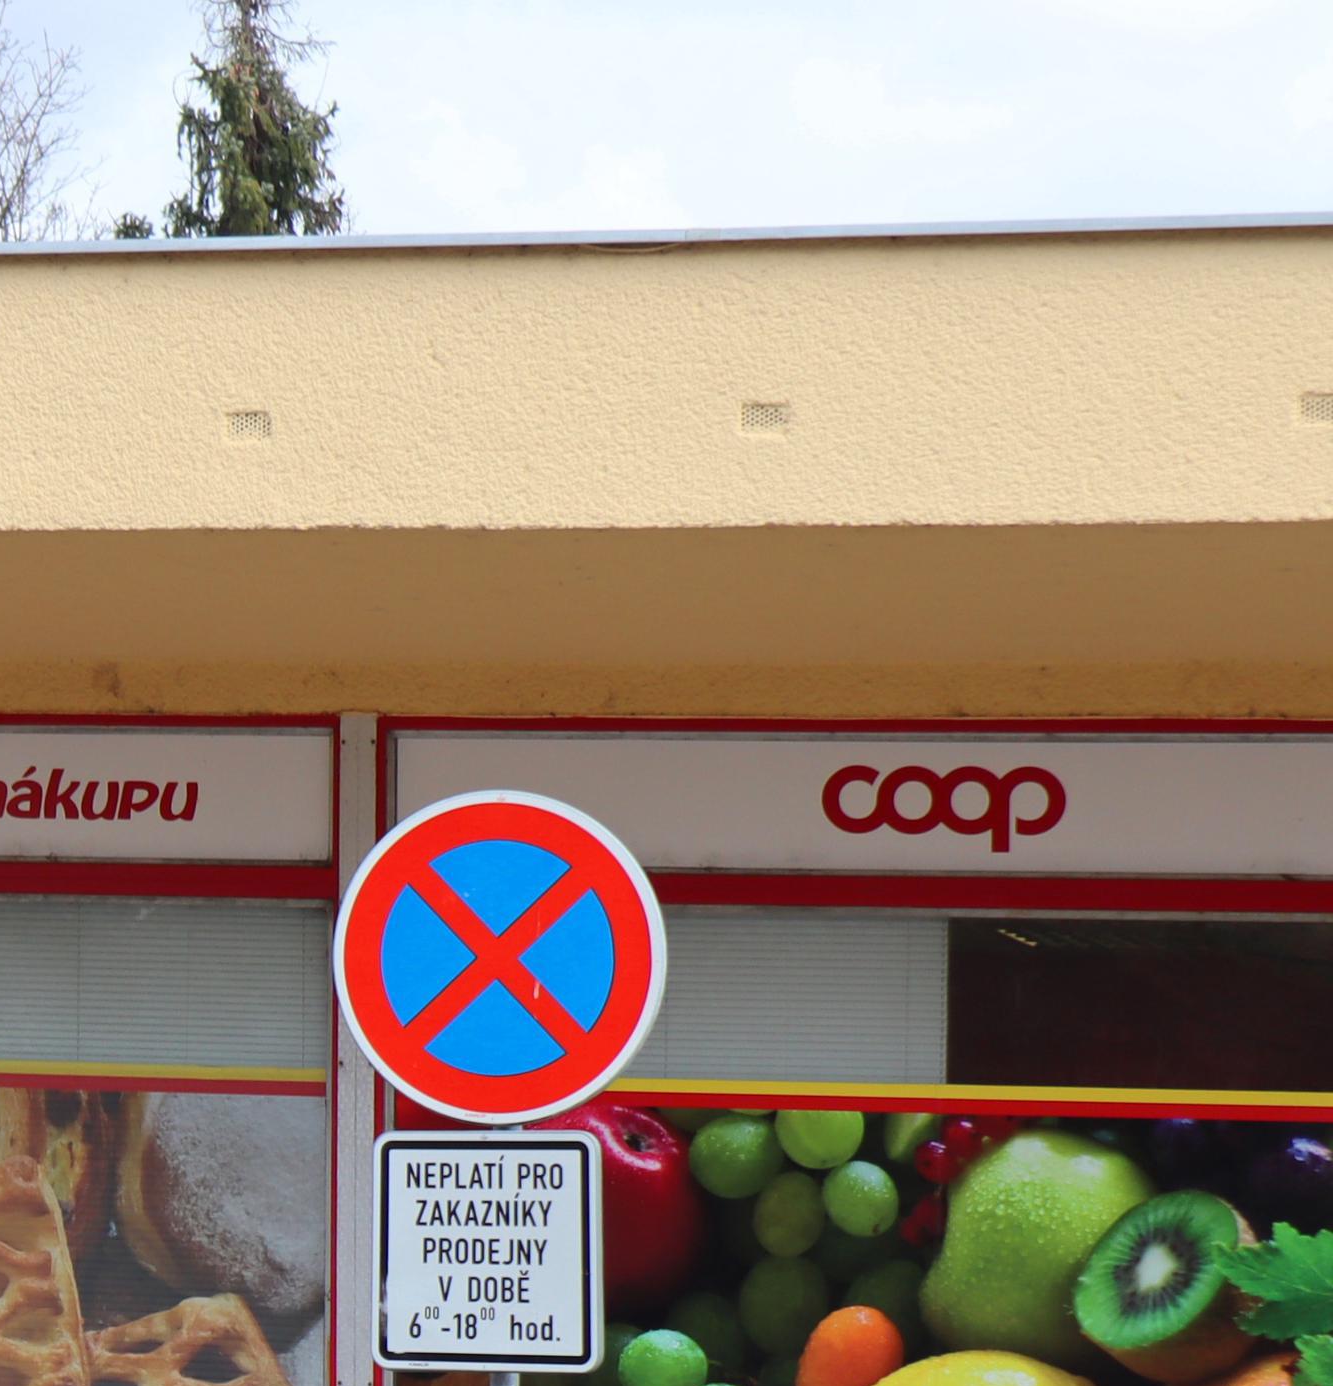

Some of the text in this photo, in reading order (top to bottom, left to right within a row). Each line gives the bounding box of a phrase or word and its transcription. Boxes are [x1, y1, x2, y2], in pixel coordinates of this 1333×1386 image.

[822, 765, 1066, 853] coop
[406, 1155, 564, 1190] NEPLATÍ PRO
[415, 1192, 552, 1227] ZAKAZNÍKY
[422, 1237, 548, 1266] PRODEJNY
[438, 1270, 531, 1303] V DOBĚ
[510, 1314, 562, 1342] hod.
